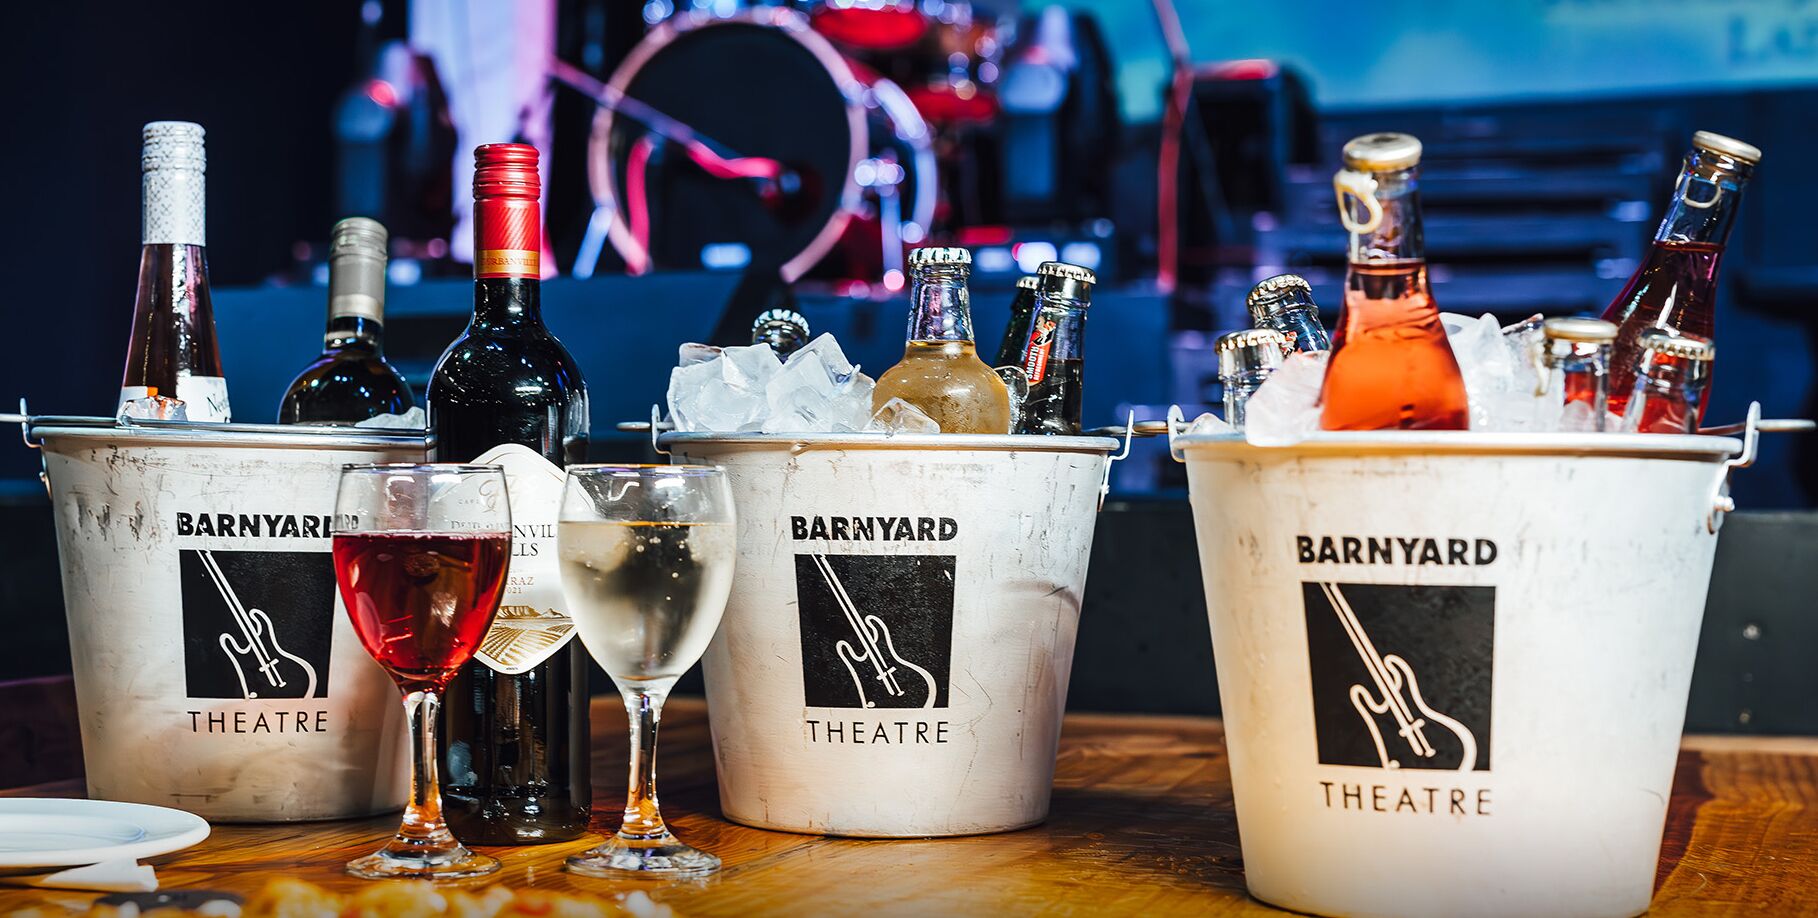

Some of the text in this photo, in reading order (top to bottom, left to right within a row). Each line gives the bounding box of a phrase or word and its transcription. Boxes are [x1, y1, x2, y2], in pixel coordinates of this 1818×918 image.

[1026, 346, 1039, 379] SMOOTH
[791, 515, 958, 541] BARNYARD
[1296, 535, 1497, 566] BARNYARD
[187, 711, 328, 733] THEATRE
[806, 720, 949, 744] THEATRE
[1319, 781, 1493, 816] THEATRE
